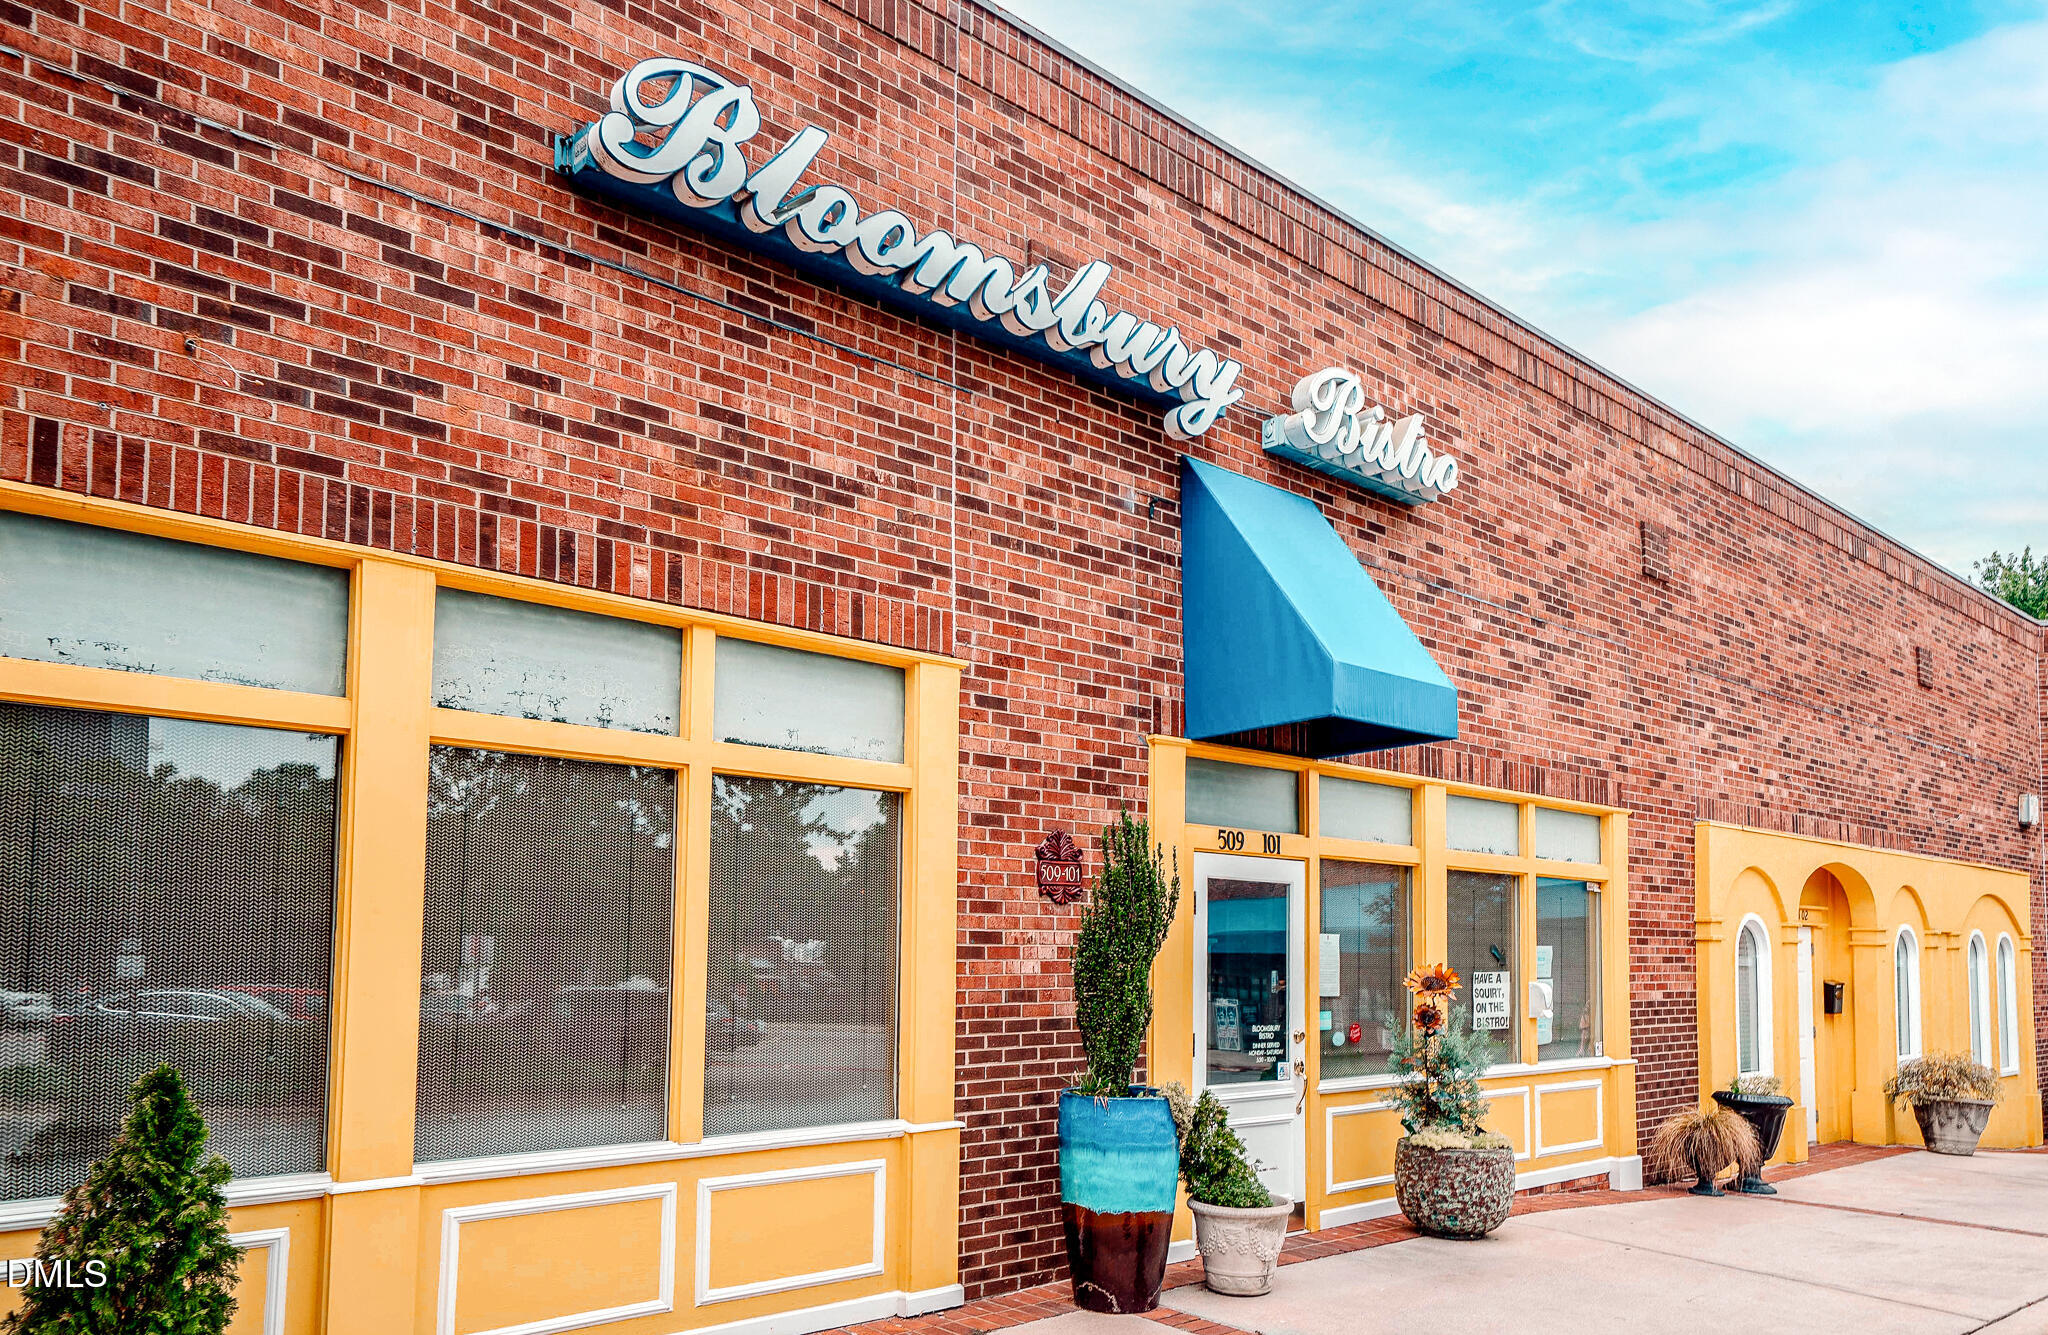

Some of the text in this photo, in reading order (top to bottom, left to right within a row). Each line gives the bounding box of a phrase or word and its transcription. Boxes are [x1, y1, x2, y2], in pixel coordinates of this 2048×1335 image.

[588, 57, 1244, 441] Bloomsbury
[1294, 366, 1459, 494] Bistro
[1218, 829, 1280, 855] 509 101
[1041, 865, 1080, 882] 509-101
[1474, 973, 1502, 984] HAVE A
[1474, 988, 1505, 999] SQUIRT,
[1476, 1002, 1504, 1013] ON THE
